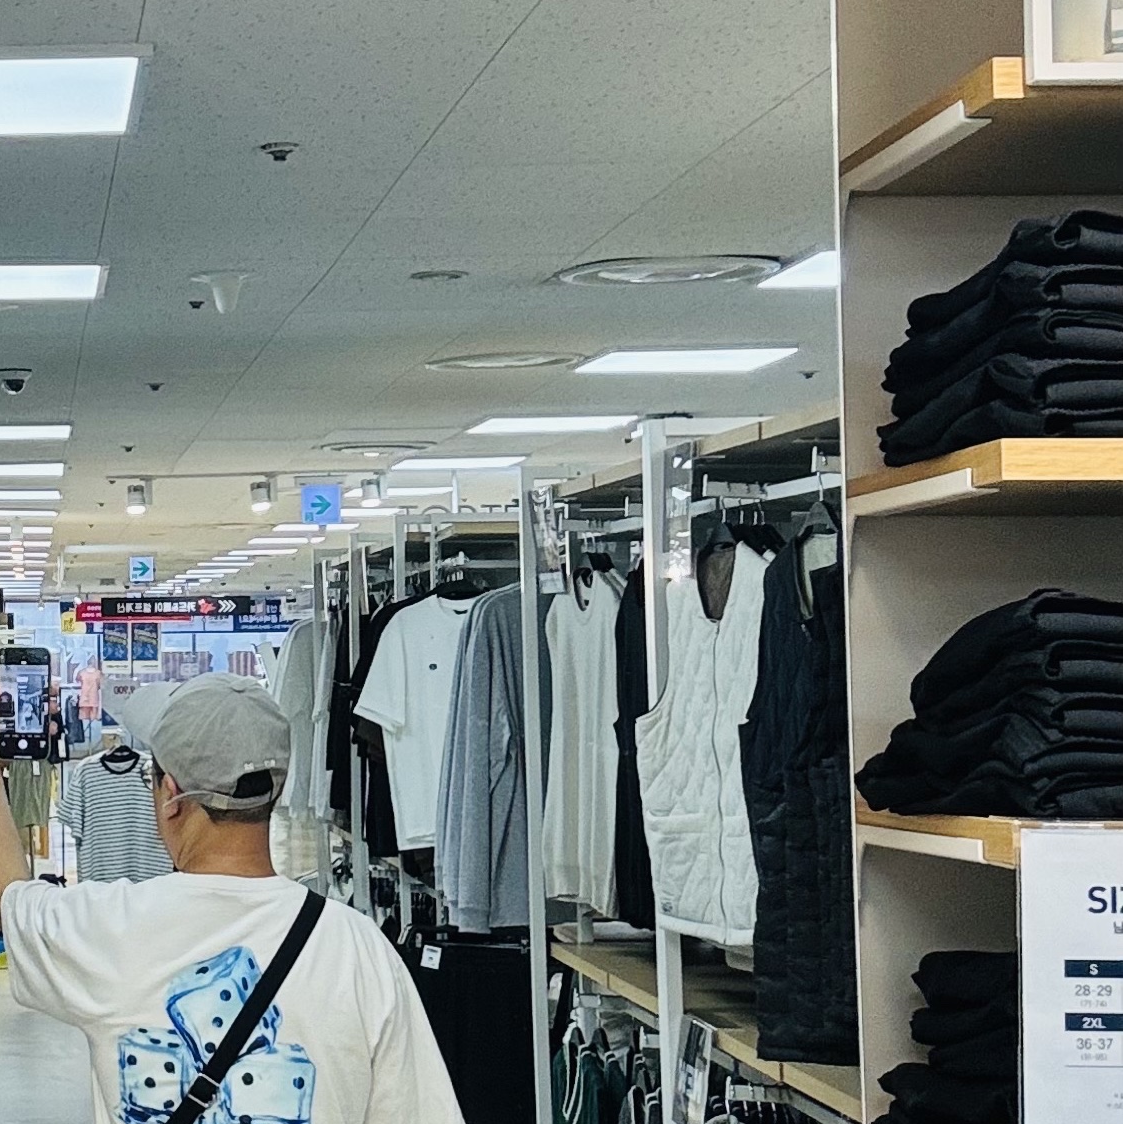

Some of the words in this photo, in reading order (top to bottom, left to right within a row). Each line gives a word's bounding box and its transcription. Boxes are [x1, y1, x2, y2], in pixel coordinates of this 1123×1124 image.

[1088, 886, 1123, 914] SI
[1089, 963, 1099, 976] S
[1082, 1016, 1107, 1029] 2XL
